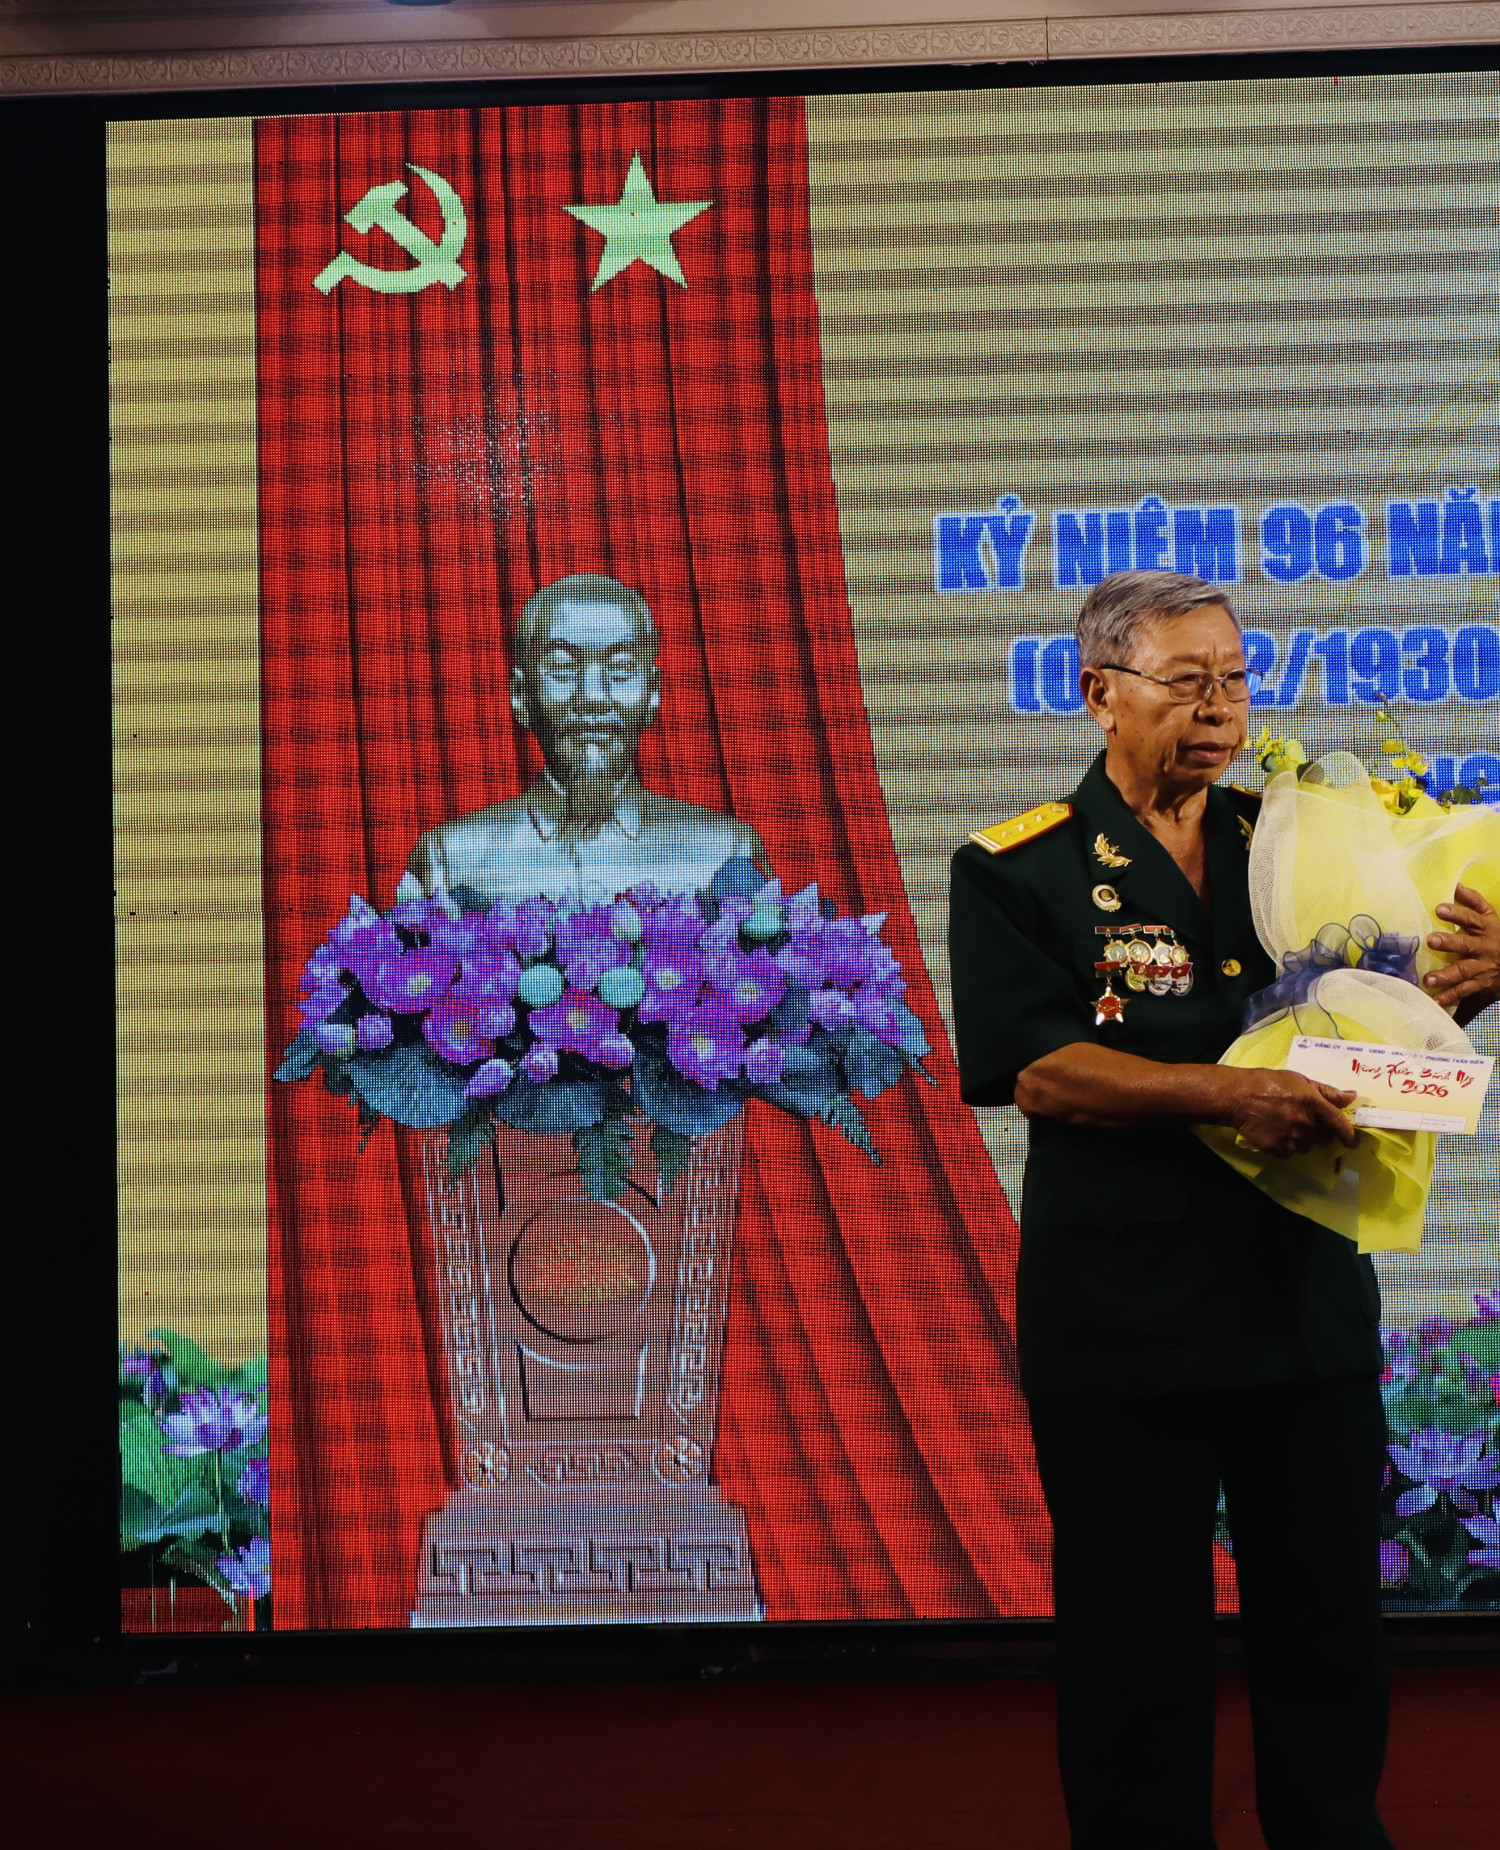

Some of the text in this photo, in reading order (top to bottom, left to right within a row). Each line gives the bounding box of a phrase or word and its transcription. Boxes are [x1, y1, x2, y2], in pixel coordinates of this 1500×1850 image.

[939, 497, 1031, 589] KỶ
[1261, 503, 1364, 581] 96
[1400, 1079, 1450, 1098] 2026
